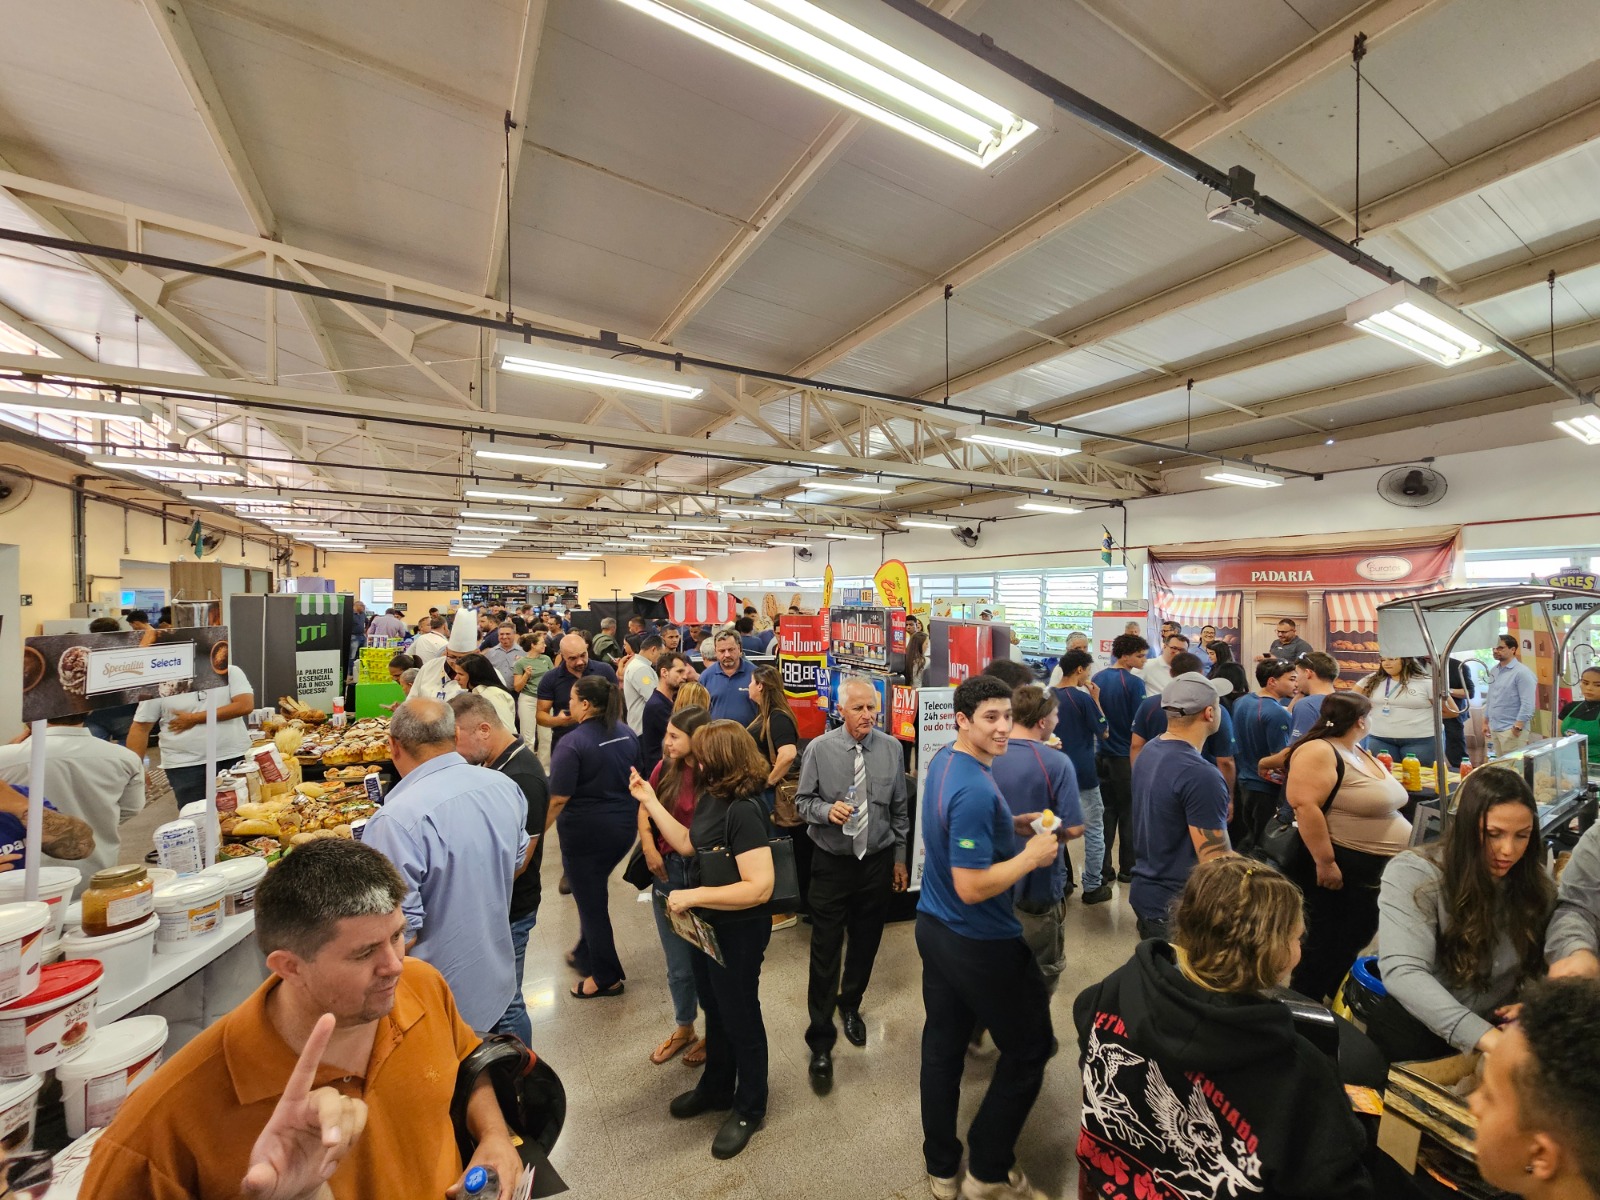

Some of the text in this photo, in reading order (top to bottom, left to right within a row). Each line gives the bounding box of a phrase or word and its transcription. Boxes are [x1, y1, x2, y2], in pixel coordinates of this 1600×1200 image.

[1251, 570, 1315, 582] PADARIA
[1551, 603, 1573, 611] SUCO
[820, 613, 830, 642] Marlboro
[840, 613, 881, 644] Marlboro
[781, 631, 822, 653] Marlboro
[151, 657, 182, 669] Selecta
[305, 667, 334, 676] PARCERIA
[298, 674, 331, 683] ESSENCIAL
[314, 680, 334, 688] NOSSO
[298, 686, 327, 696] SUCESSO!
[893, 687, 916, 710] L&M
[924, 701, 955, 711] Telecon
[923, 711, 939, 721] 24h
[934, 721, 944, 731] do
